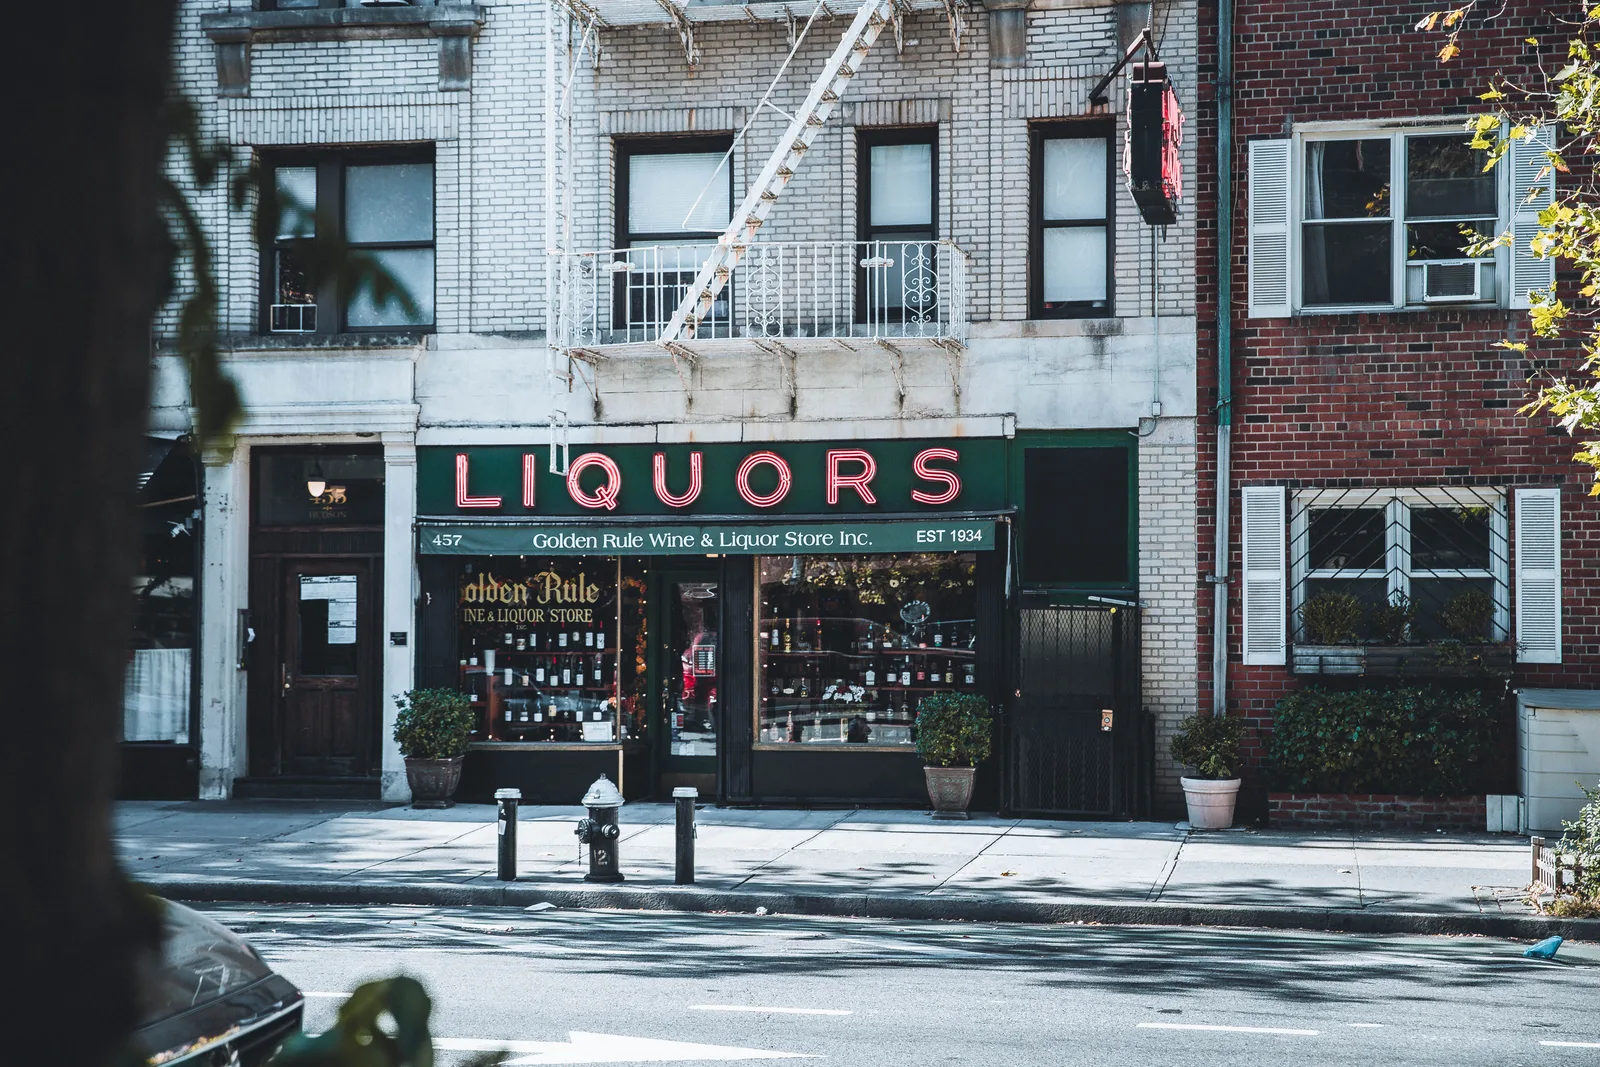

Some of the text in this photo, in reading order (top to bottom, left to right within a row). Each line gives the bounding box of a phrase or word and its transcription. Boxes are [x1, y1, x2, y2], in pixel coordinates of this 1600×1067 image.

[455, 447, 963, 512] LIQUORS
[432, 534, 463, 547] 457
[533, 531, 873, 550] Golden Rule Wine & Liquor Store Inc.
[916, 529, 983, 543] EST 1934
[464, 571, 600, 605] olden Rule
[464, 608, 593, 624] INE & LIQUOR STORE
